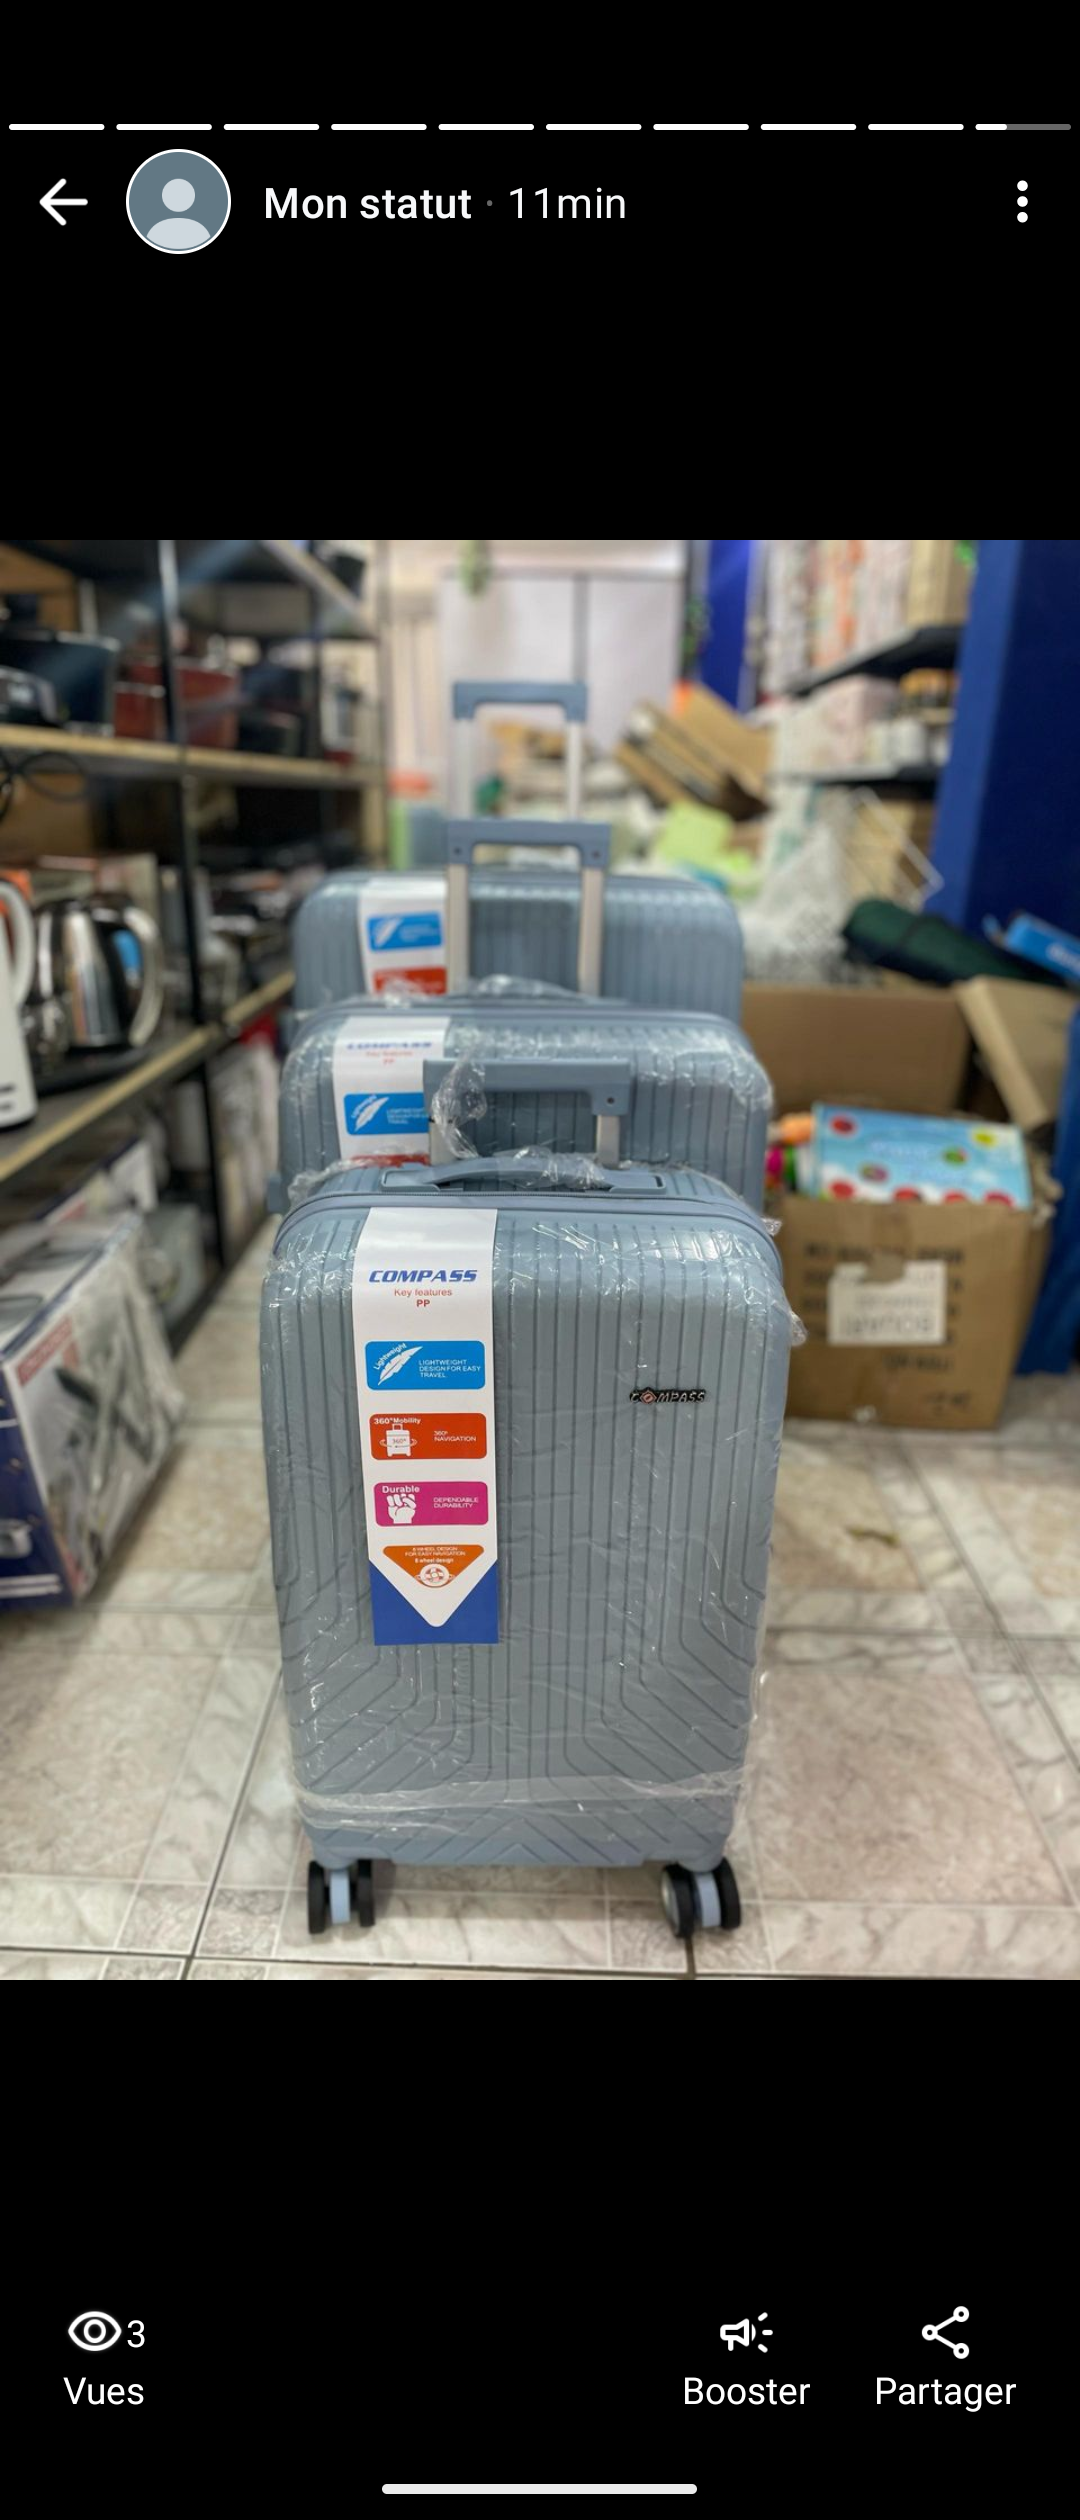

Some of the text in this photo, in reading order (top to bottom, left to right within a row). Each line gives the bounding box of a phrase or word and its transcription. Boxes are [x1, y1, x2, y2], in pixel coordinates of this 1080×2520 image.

[369, 1270, 477, 1283] COMPASS
[394, 1288, 452, 1298] Key features
[416, 1299, 431, 1308] PP
[373, 1342, 408, 1371] Lightweight
[382, 1485, 420, 1494] Durable
